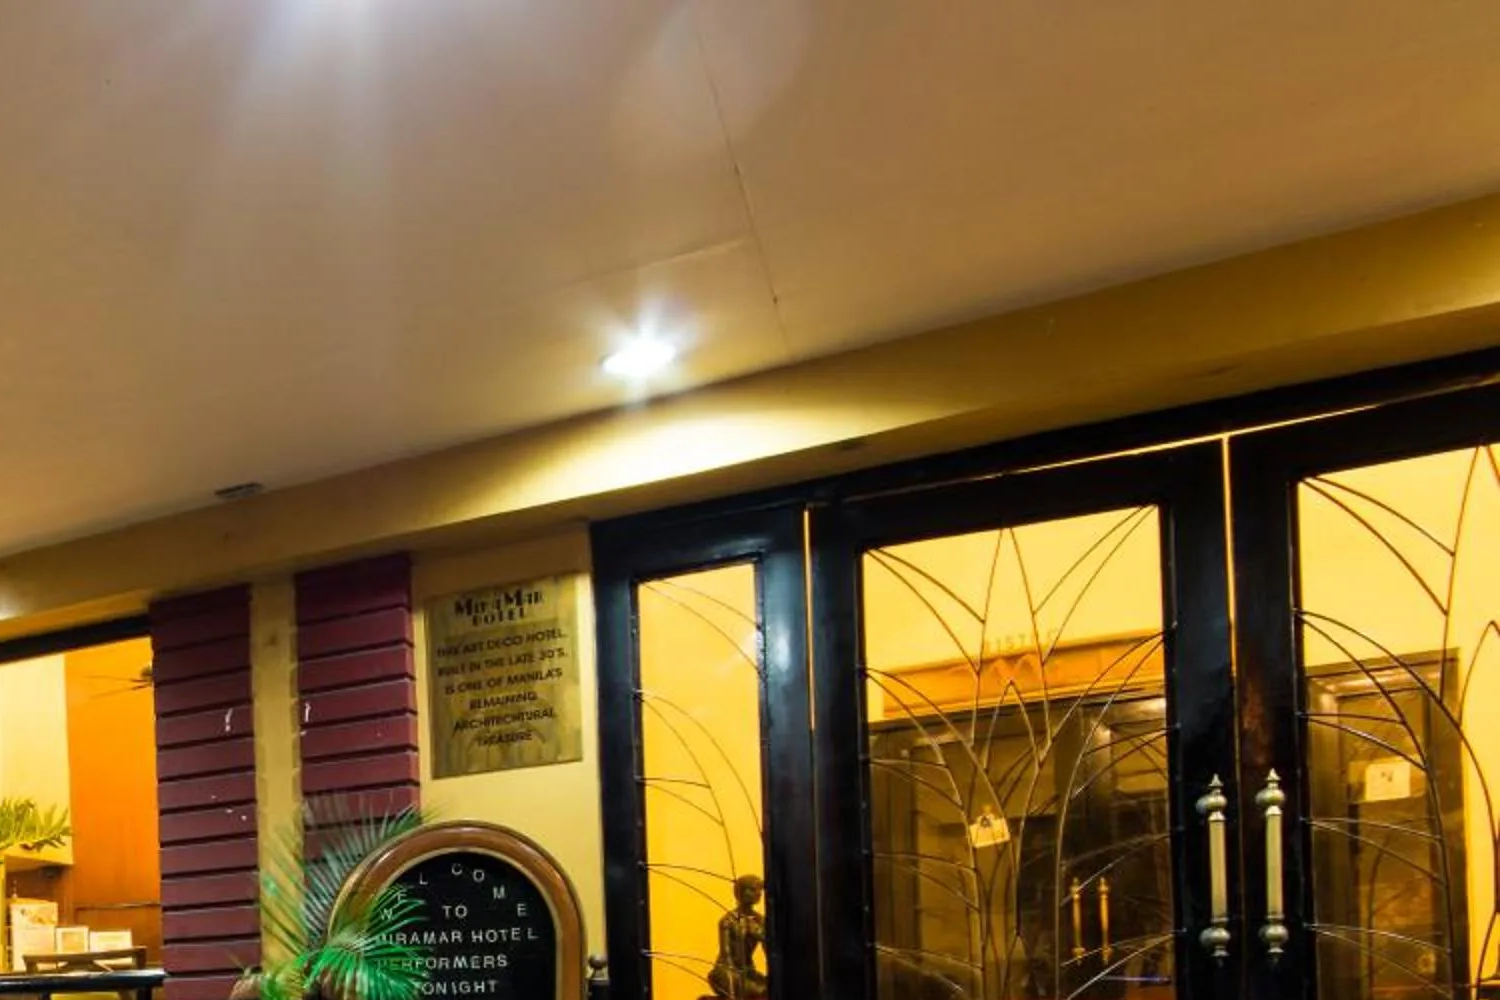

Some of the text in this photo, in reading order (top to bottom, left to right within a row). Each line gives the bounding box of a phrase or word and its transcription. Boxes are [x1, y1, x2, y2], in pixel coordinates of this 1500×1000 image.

[463, 641, 484, 655] ART
[486, 635, 523, 650] DECO
[470, 661, 481, 673] IN
[484, 657, 505, 669] THE
[509, 653, 534, 666] LATE
[458, 681, 482, 693] ONE
[486, 677, 502, 688] OF
[469, 691, 538, 710] REMAINING
[442, 904, 468, 919] TO
[471, 927, 539, 944] HOTEL
